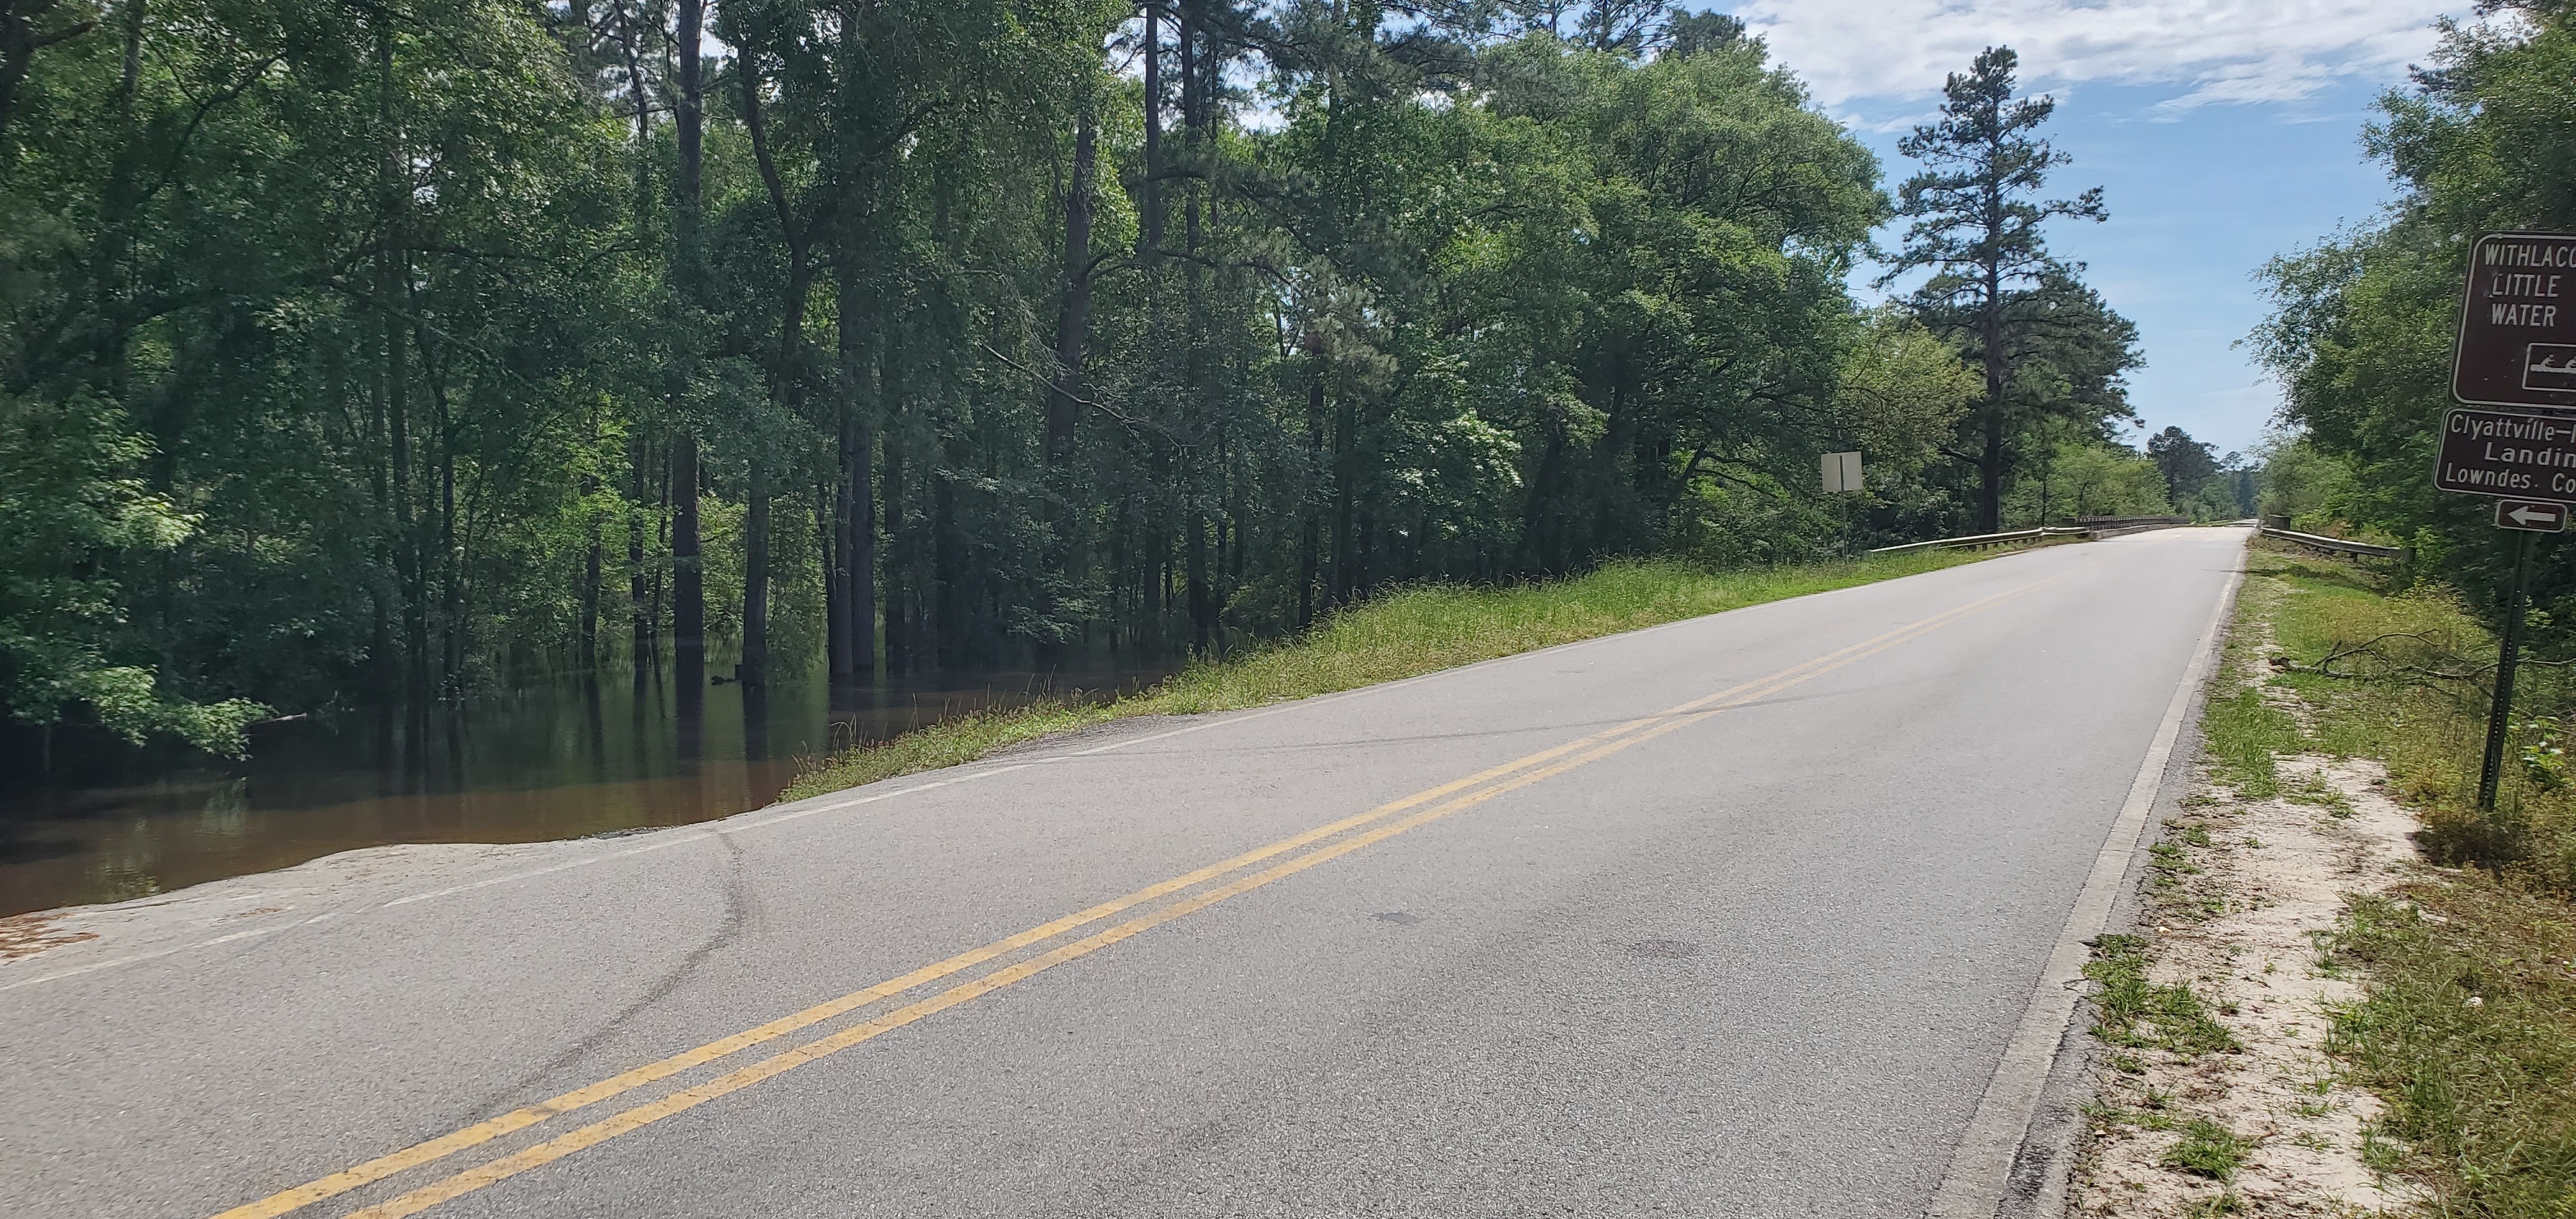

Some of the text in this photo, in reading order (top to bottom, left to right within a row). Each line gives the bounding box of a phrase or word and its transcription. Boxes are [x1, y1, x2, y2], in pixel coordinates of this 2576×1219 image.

[2492, 273, 2561, 298] LITTLE
[2492, 303, 2556, 327] WATER
[2445, 463, 2531, 489] Lowndes
